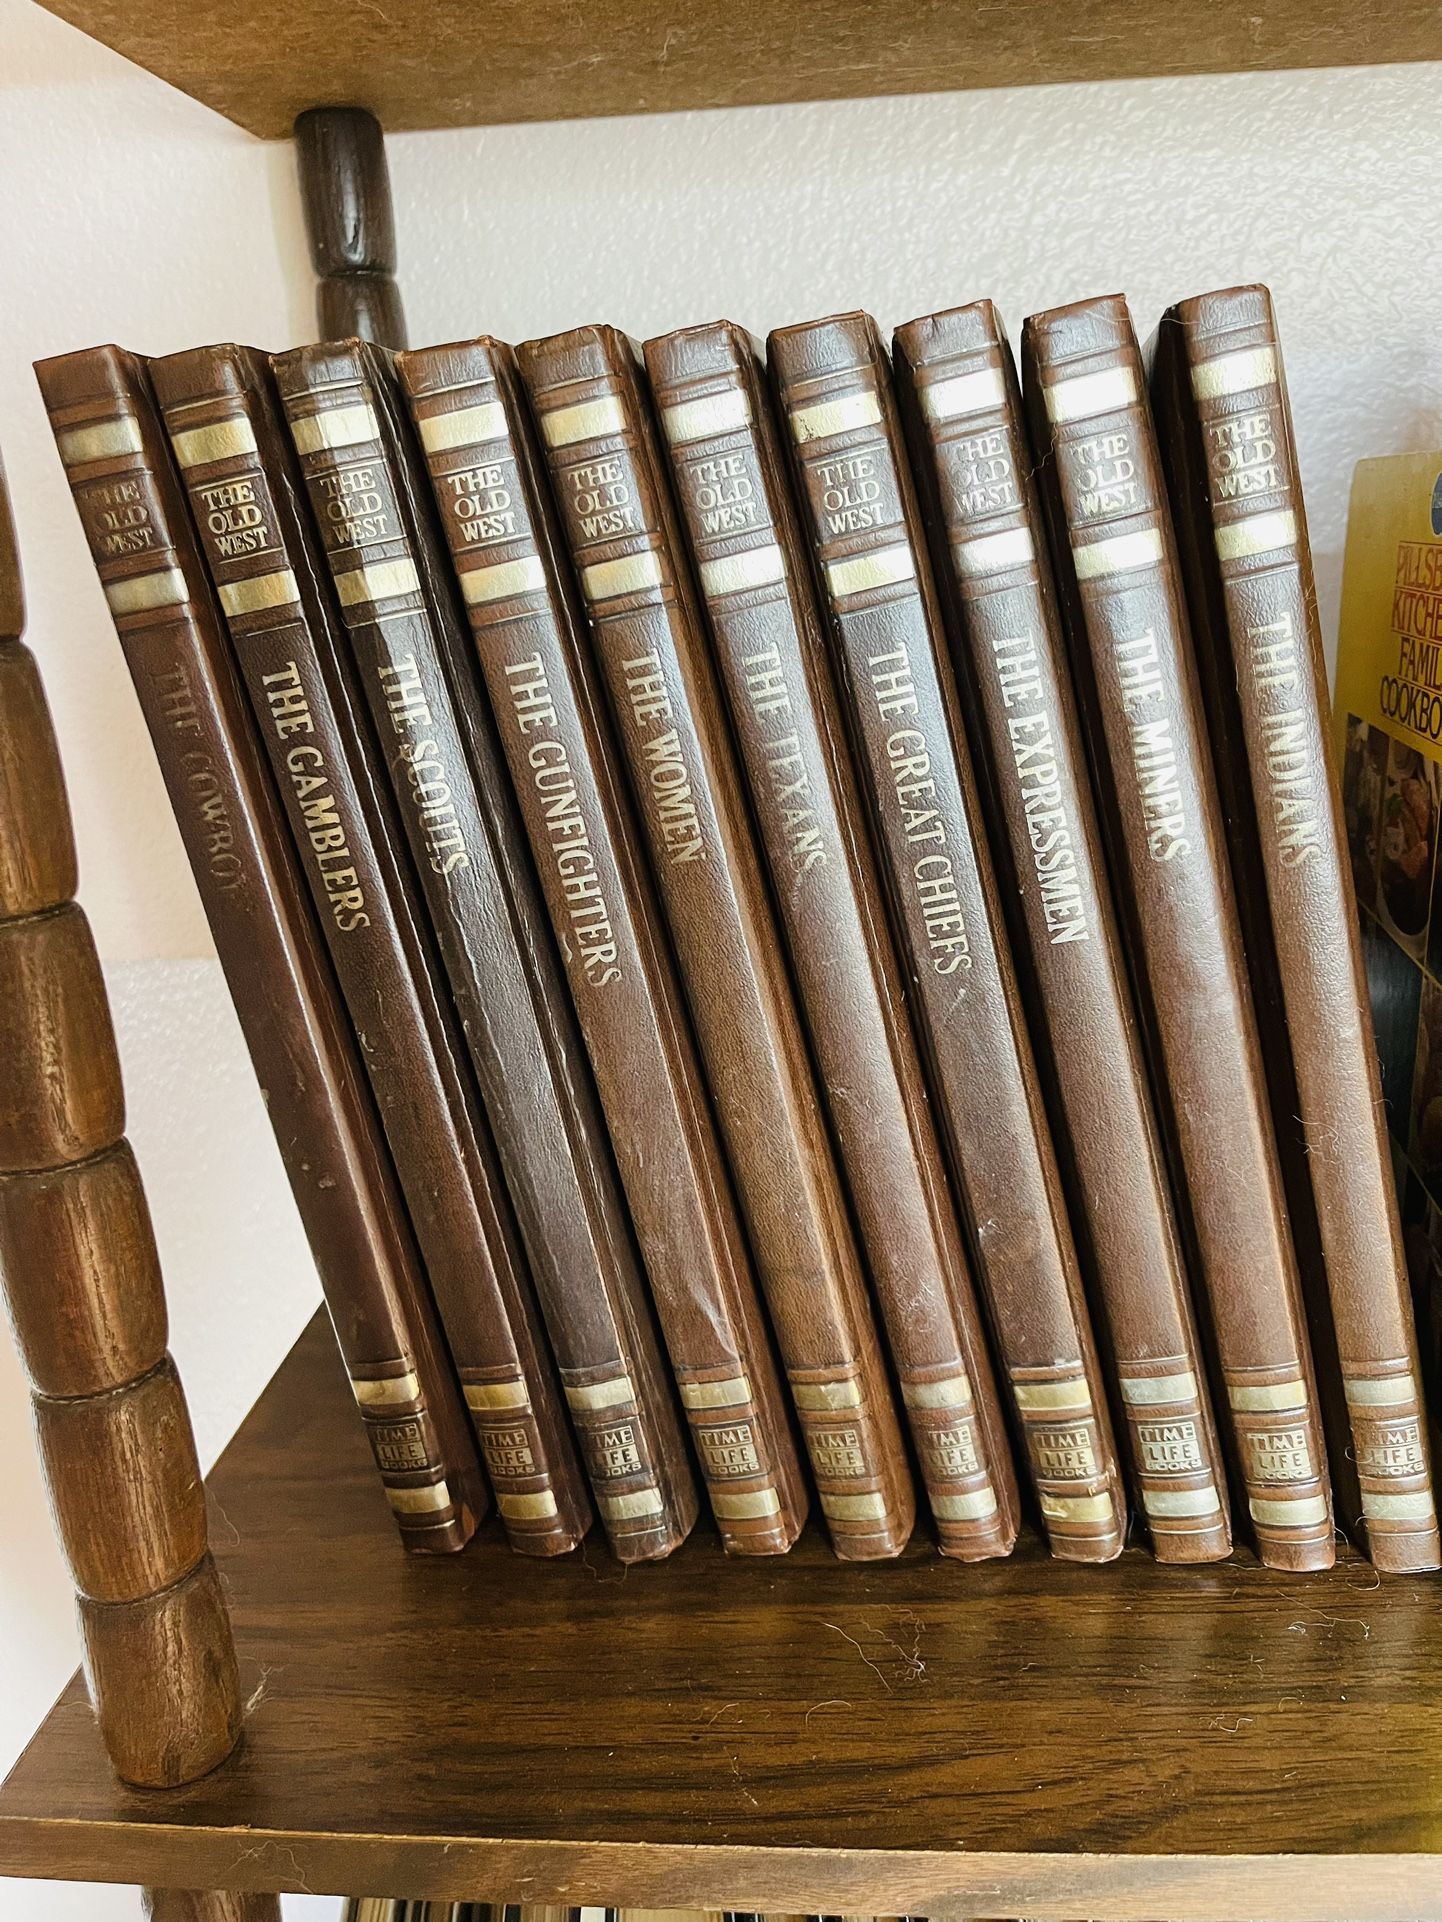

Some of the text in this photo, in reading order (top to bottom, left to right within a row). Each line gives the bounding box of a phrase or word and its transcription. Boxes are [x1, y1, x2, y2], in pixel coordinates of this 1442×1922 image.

[1210, 412, 1271, 447] THE
[954, 434, 1003, 462] THE
[1071, 433, 1129, 464] THE
[1213, 440, 1276, 473] OLD
[320, 468, 375, 498] THE
[448, 466, 504, 496] THE
[569, 460, 623, 490] THE
[691, 455, 746, 485] THE
[818, 457, 874, 486] THE
[955, 459, 1010, 488] OLD
[1077, 458, 1134, 490] OLD
[1215, 466, 1277, 499] WEST
[202, 481, 255, 511] THE
[326, 492, 383, 522] OLD
[454, 489, 511, 518] OLD
[575, 485, 629, 515] OLD
[695, 479, 753, 510] OLD
[823, 480, 880, 511] OLD
[954, 483, 1013, 514] WEST
[1079, 483, 1136, 517] WEST
[208, 504, 263, 535] OLD
[332, 514, 387, 543] WEST
[459, 512, 515, 542] WEST
[580, 507, 635, 537] WEST
[701, 502, 756, 532] WEST
[828, 503, 883, 534] WEST
[98, 526, 153, 554] WEST
[215, 527, 268, 556] WEST
[1380, 675, 1442, 739] COOKBO
[1115, 627, 1192, 862] THE MINERS
[1248, 611, 1322, 868] THE INDIANS
[377, 653, 470, 875] THE SCOUTS
[622, 648, 706, 865] THE WOMEN
[742, 642, 827, 873] THE TEXANS
[262, 661, 371, 931] THE GAMBLERS
[992, 635, 1090, 945] THE EXPRESSMEN
[505, 652, 621, 988] THE GUNFIGHTERS
[868, 642, 973, 976] THE GREAT CHIEFS
[375, 1424, 417, 1441] TIME
[482, 1430, 526, 1446] TIME
[702, 1428, 749, 1445] TIME
[811, 1431, 856, 1447] TIME
[1035, 1431, 1088, 1447] TIME
[1141, 1425, 1195, 1441] TIME
[1249, 1434, 1306, 1450] TIME
[382, 1444, 418, 1460] LIFE
[489, 1450, 525, 1465] LIFE
[711, 1447, 749, 1465] LIFE
[818, 1451, 856, 1466] LIFE
[1043, 1451, 1086, 1466] LIFE
[1147, 1459, 1201, 1470] BOOKS
[1151, 1445, 1192, 1460] LIFE
[1260, 1453, 1302, 1468] LIFE
[710, 1463, 760, 1474] BOOKS
[1043, 1467, 1096, 1477] BOOKS
